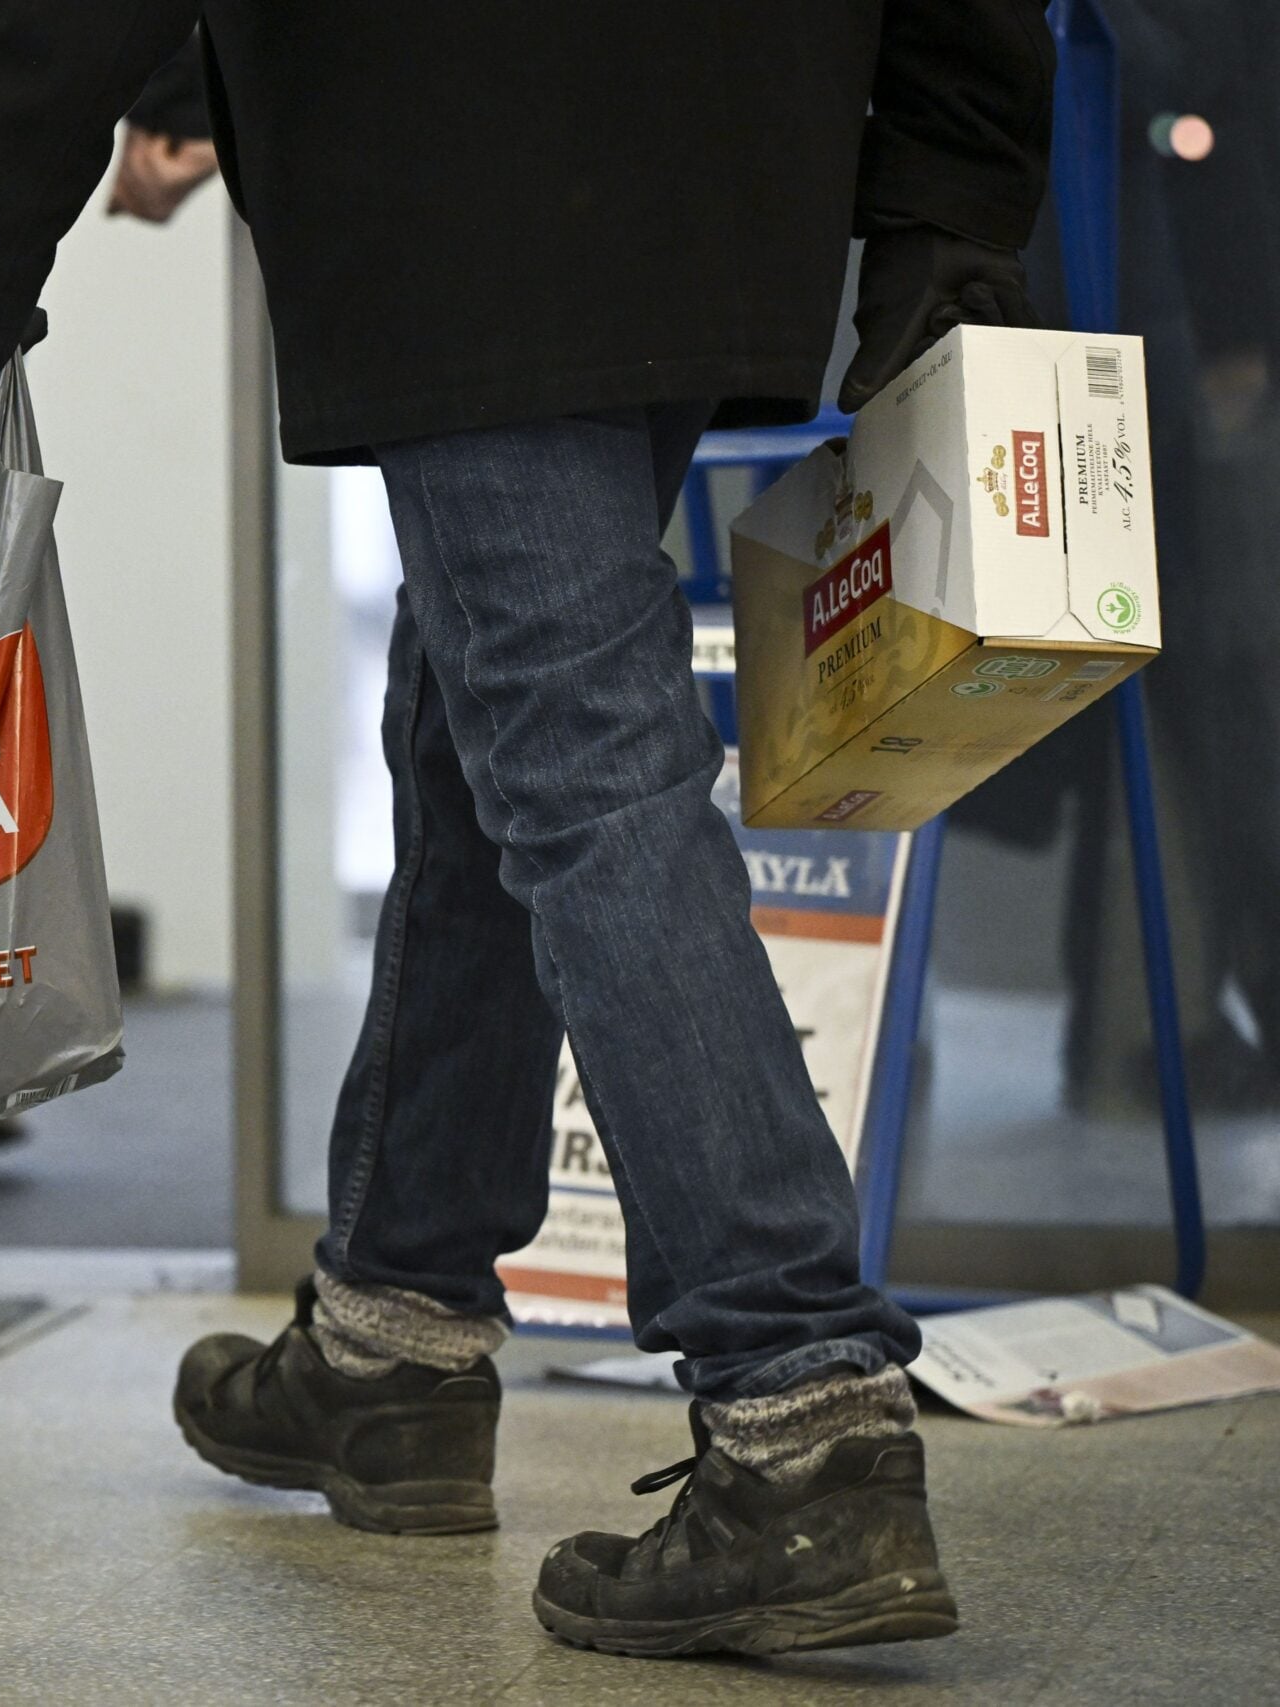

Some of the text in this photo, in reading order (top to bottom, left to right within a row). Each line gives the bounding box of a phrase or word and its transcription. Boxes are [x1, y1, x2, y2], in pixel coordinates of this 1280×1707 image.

[1075, 434, 1089, 504] PREMIUM
[1111, 437, 1134, 503] 4.5%
[818, 615, 882, 684] PREMIUM
[870, 736, 924, 754] 18
